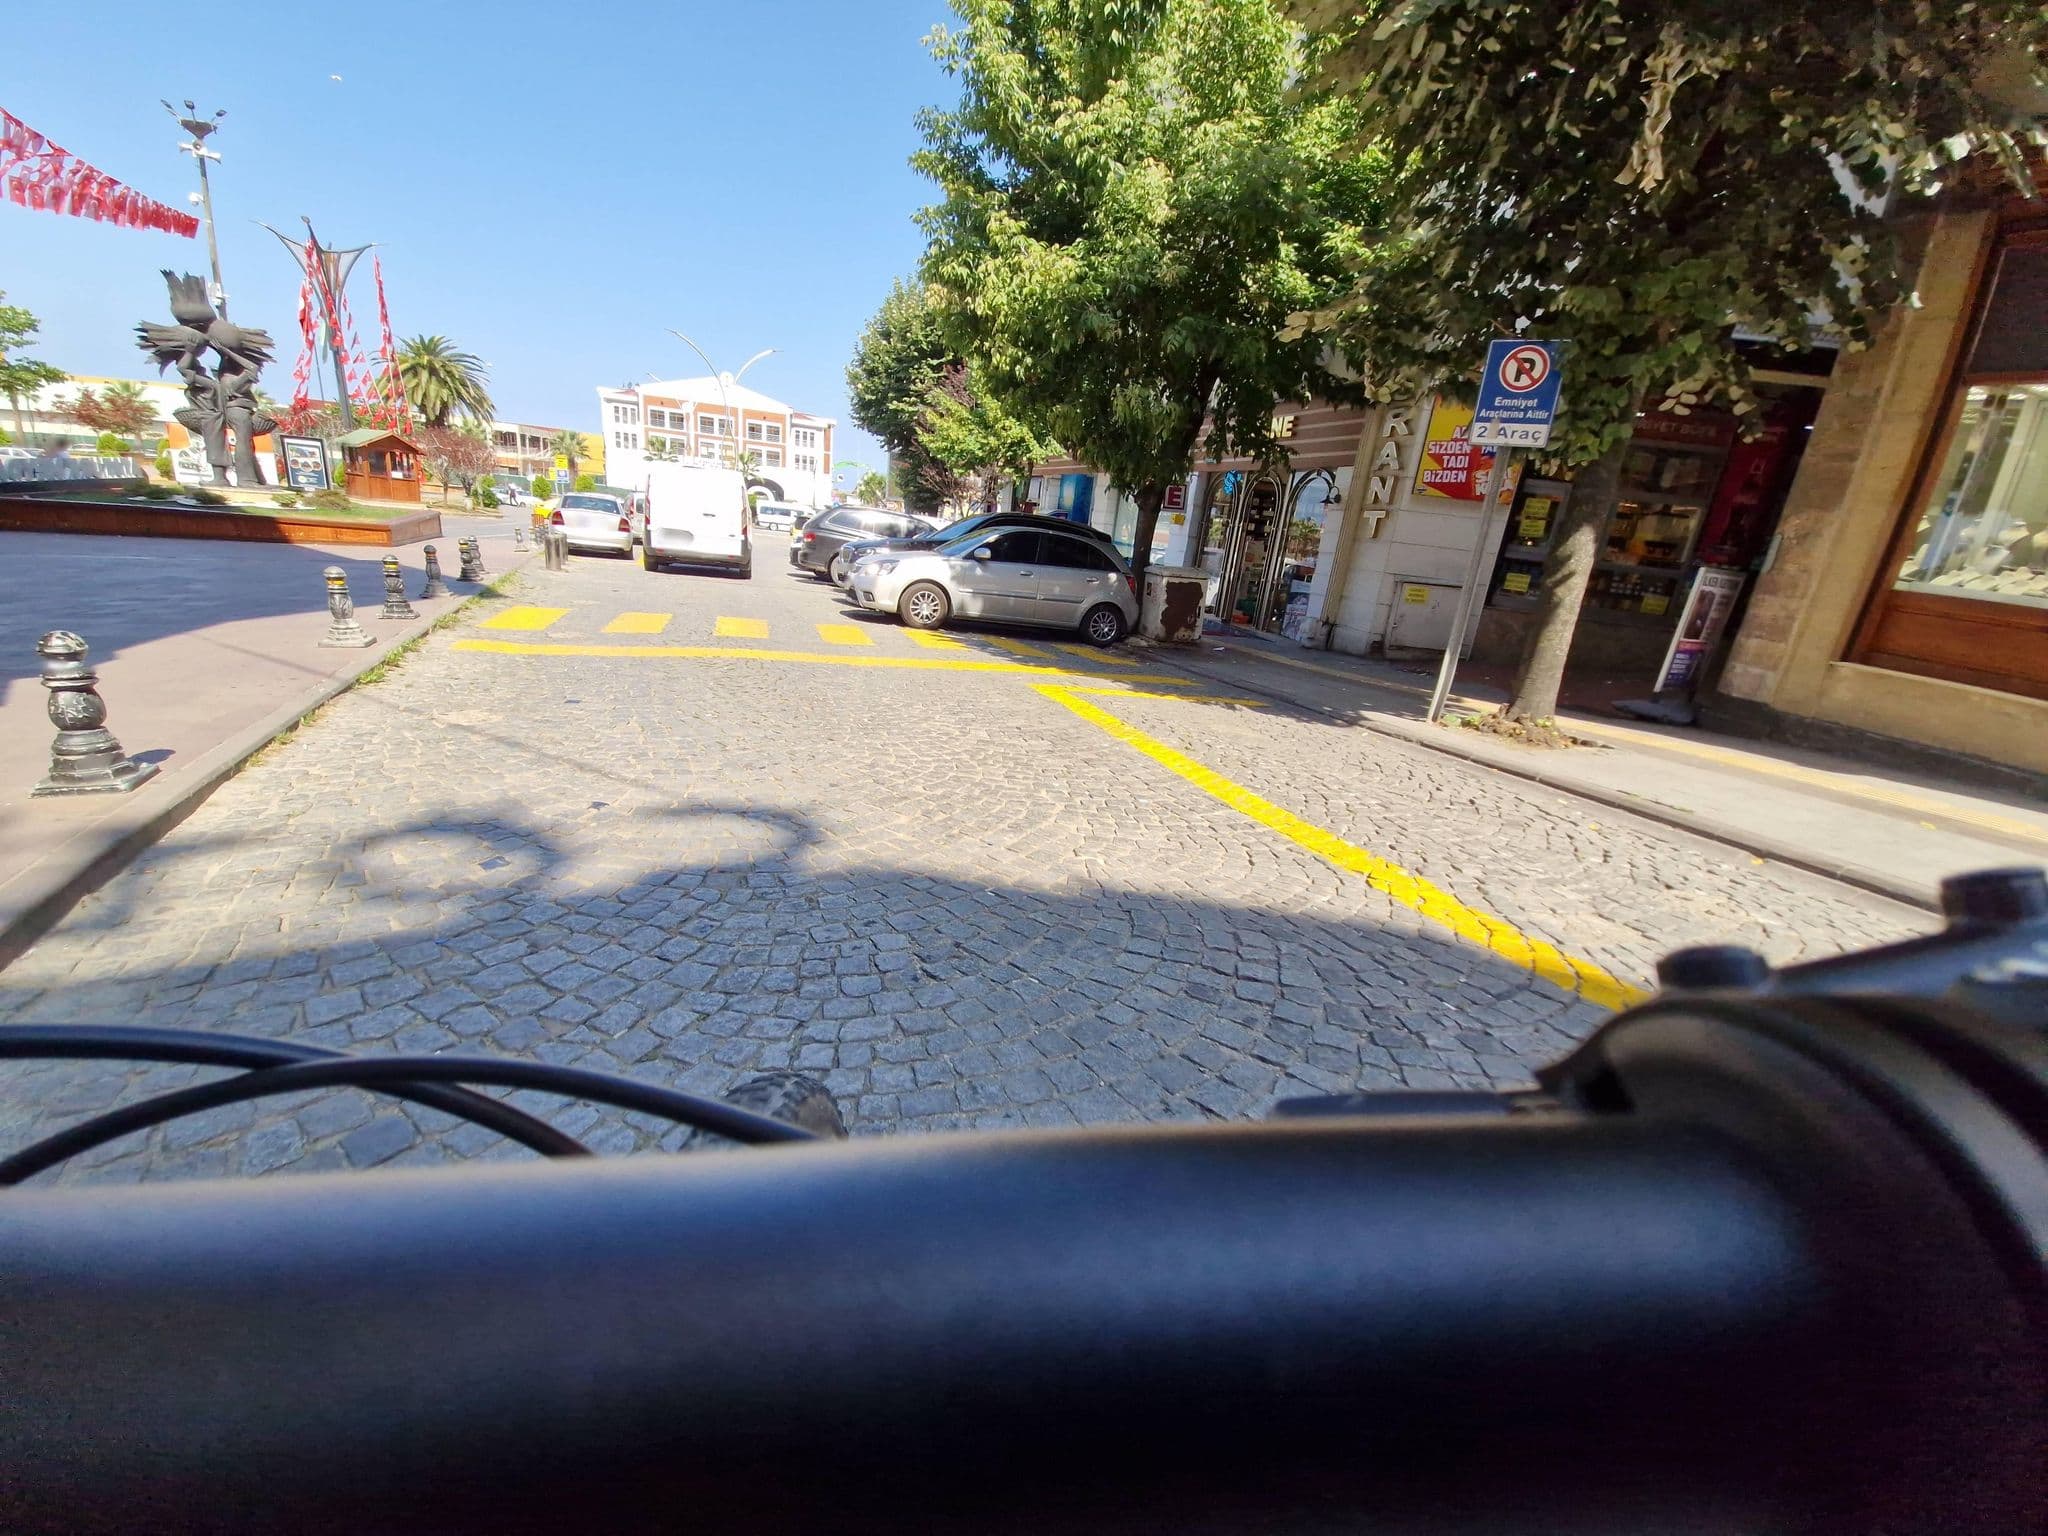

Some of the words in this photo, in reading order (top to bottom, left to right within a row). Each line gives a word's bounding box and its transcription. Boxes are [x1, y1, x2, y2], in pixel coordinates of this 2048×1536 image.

[1494, 396, 1538, 409] Emniyet
[1264, 415, 1295, 440] NE
[1476, 425, 1488, 438] 2
[1496, 426, 1542, 443] Araç
[1442, 455, 1469, 468] TADI
[1423, 470, 1467, 483] BİZDEN
